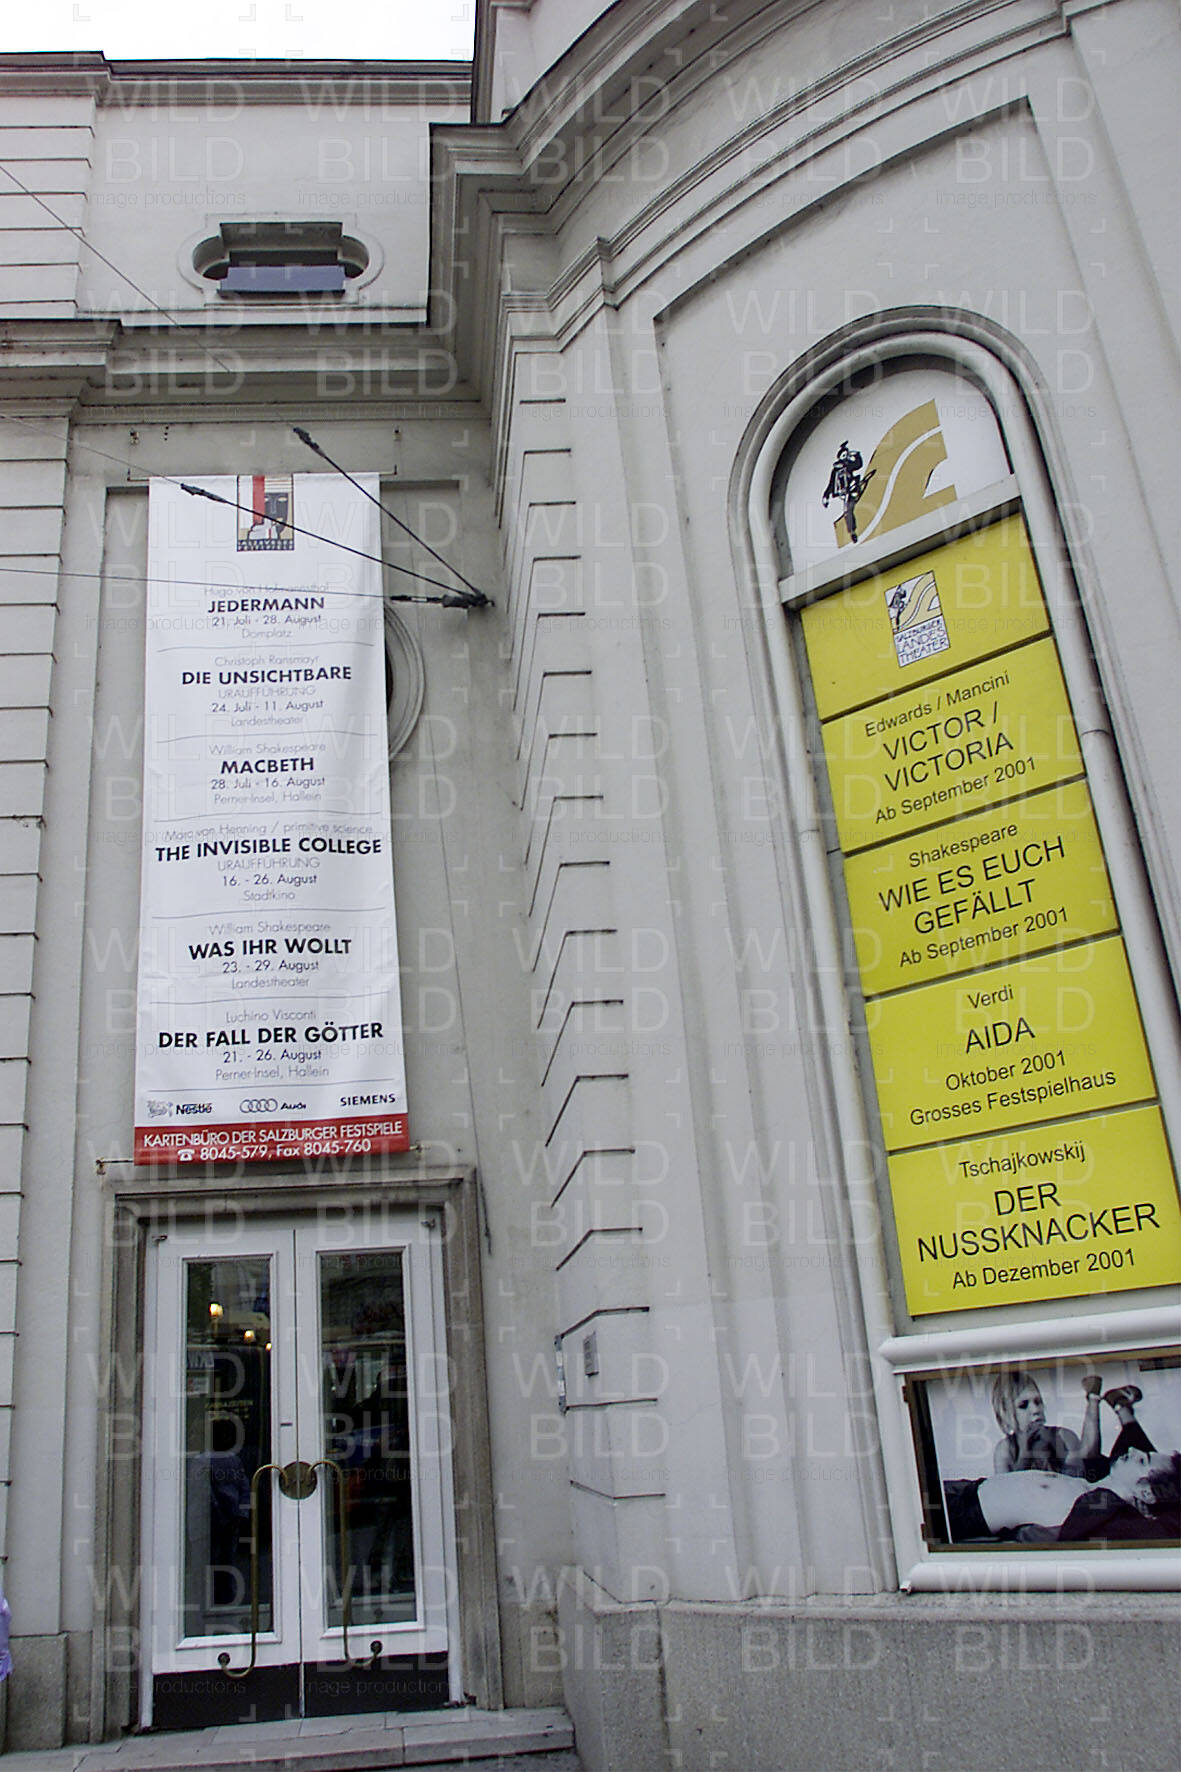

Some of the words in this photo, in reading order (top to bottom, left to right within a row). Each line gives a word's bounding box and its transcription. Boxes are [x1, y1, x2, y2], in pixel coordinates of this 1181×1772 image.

[208, 597, 324, 613] JEDERMANN
[234, 616, 251, 626] Juli
[284, 615, 321, 626] August
[242, 628, 292, 640] Domplatz
[214, 656, 265, 668] Christoph
[269, 655, 320, 666] Ransmayr
[182, 672, 211, 684] DIE
[219, 666, 352, 684] UNSICHTBARE
[212, 702, 230, 713] 24.
[234, 702, 252, 712] Juli
[286, 700, 324, 712] August
[865, 704, 932, 737] Edwards
[936, 696, 941, 710] /
[946, 670, 1010, 706] Mancini
[231, 716, 304, 728] Landestheater
[883, 709, 984, 760] VICTOR
[993, 701, 998, 724] /
[208, 744, 252, 755] William
[256, 743, 326, 755] Shakespeare
[221, 758, 314, 774] MACBETH
[884, 732, 1014, 792] VICTORIA
[234, 778, 252, 789] Juli
[286, 777, 325, 790] August
[876, 806, 897, 824] Ab
[901, 774, 989, 815] September
[994, 757, 1036, 783] 2001
[282, 792, 322, 801] Hallein
[220, 823, 267, 836] Henning
[156, 844, 190, 862] THE
[197, 838, 290, 858] INVISIBLE
[298, 838, 382, 854] COLLEGE
[909, 824, 1018, 868] Shakespeare
[223, 874, 240, 887] 16.
[254, 874, 274, 885] 26.
[276, 874, 318, 887] August
[878, 878, 931, 912] WIE
[938, 866, 974, 894] ES
[982, 836, 1065, 881] EUCH
[243, 890, 296, 902] Stadtkino
[914, 878, 1036, 934] GEFÄLLT
[257, 921, 331, 936] Shakespeare
[900, 950, 922, 968] Ab
[927, 922, 1019, 960] September
[1024, 907, 1068, 934] 2001
[189, 941, 234, 960] WAS
[242, 938, 278, 955] IHR
[285, 938, 352, 954] WOLLT
[223, 962, 242, 974] 23.
[254, 960, 274, 972] 29.
[278, 960, 320, 974] August
[232, 976, 310, 990] Landestheater
[968, 984, 1014, 1009] Verdi
[226, 1012, 269, 1024] Luchino
[273, 1008, 316, 1020] Visconti
[158, 1032, 198, 1048] DER
[206, 1029, 250, 1047] FALL
[258, 1028, 297, 1044] DER
[304, 1022, 384, 1044] GÖTTER
[966, 1017, 1036, 1054] AIDA
[224, 1052, 242, 1064] 21.
[256, 1049, 276, 1062] 26.
[280, 1048, 322, 1064] August
[288, 1066, 330, 1078] Hallein
[946, 1063, 1016, 1091] Oktober
[1021, 1050, 1066, 1075] 2001
[340, 1093, 396, 1107] SIEMENS
[910, 1100, 982, 1126] Grosses
[987, 1071, 1116, 1110] Festspielhaus
[144, 1128, 230, 1148] KARTENBÜRO
[232, 1128, 257, 1143] DER
[258, 1124, 336, 1142] SALZBURGER
[340, 1120, 402, 1138] FESTSPIELE
[200, 1146, 272, 1161] 8045-579,
[276, 1144, 300, 1156] Fax
[304, 1138, 371, 1156] 8045-760
[960, 1140, 1086, 1178] Tschajkowskij
[994, 1182, 1062, 1216] DER
[918, 1203, 1160, 1263] NUSSKNACKER
[952, 1272, 977, 1290] Ab
[983, 1258, 1080, 1286] Dezember
[1086, 1248, 1136, 1272] 2001
